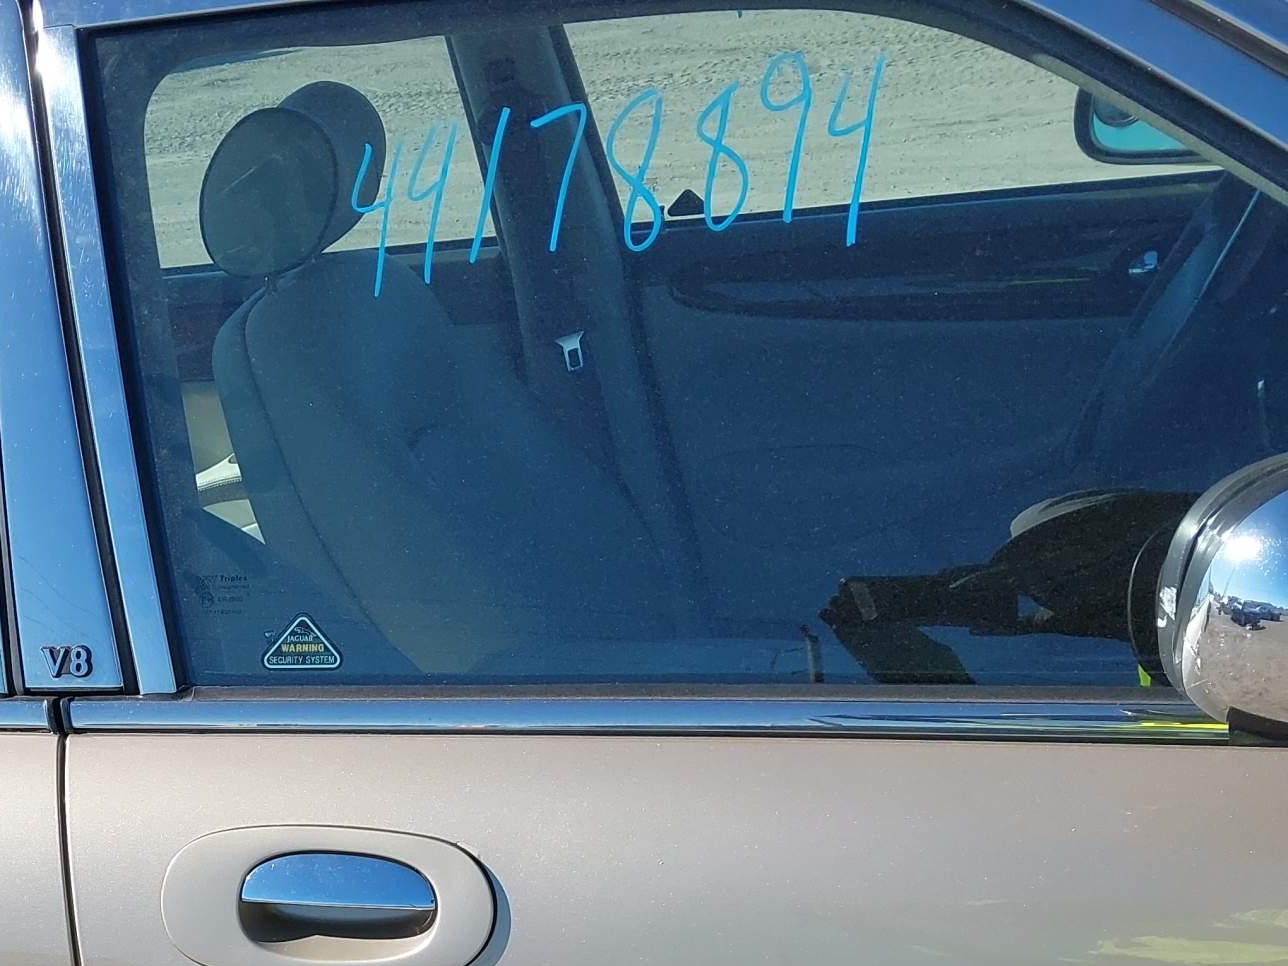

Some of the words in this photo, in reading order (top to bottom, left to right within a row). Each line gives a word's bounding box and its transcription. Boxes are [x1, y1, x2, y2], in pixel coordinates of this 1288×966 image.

[351, 50, 885, 298] 44178894
[287, 635, 314, 643] JAGUAR
[281, 643, 325, 652] WARNING
[40, 645, 93, 679] V8
[269, 655, 303, 664] SECURITY
[306, 655, 336, 664] SYSTEM
